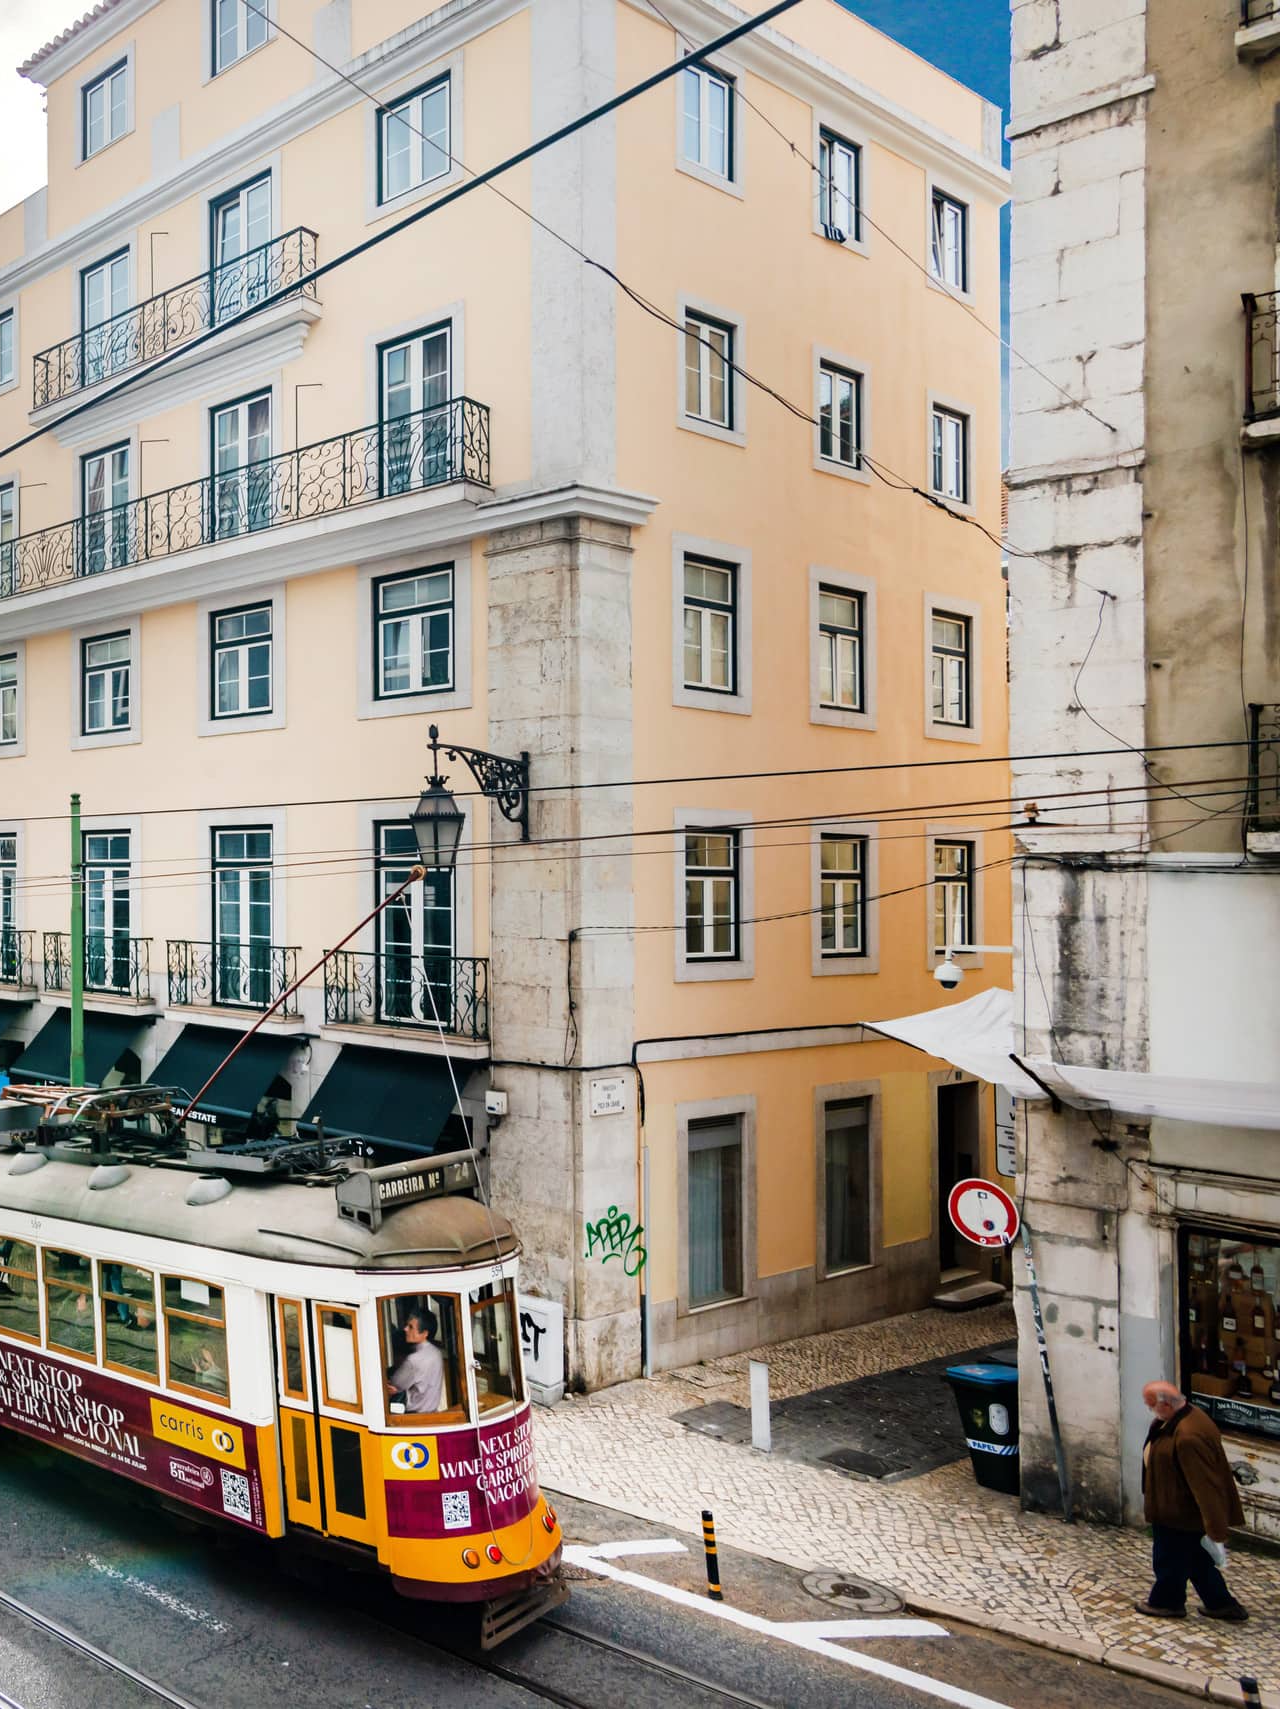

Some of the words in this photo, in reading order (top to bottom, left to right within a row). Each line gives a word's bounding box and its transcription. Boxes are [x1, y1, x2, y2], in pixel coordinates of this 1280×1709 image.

[187, 1110, 217, 1124] ESTATE
[379, 1175, 425, 1200] CARREIRA
[39, 1362, 83, 1394] STOP
[0, 1369, 9, 1385] &
[11, 1370, 71, 1412] SPIRITS
[74, 1395, 125, 1430] SHOP
[54, 1406, 146, 1460] NACIONAL
[159, 1413, 205, 1441] carris
[480, 1431, 512, 1456] NEXT
[971, 1441, 998, 1452] PAPEL
[439, 1458, 483, 1479] WINE
[485, 1458, 495, 1470] &
[495, 1438, 531, 1469] SPIRITS
